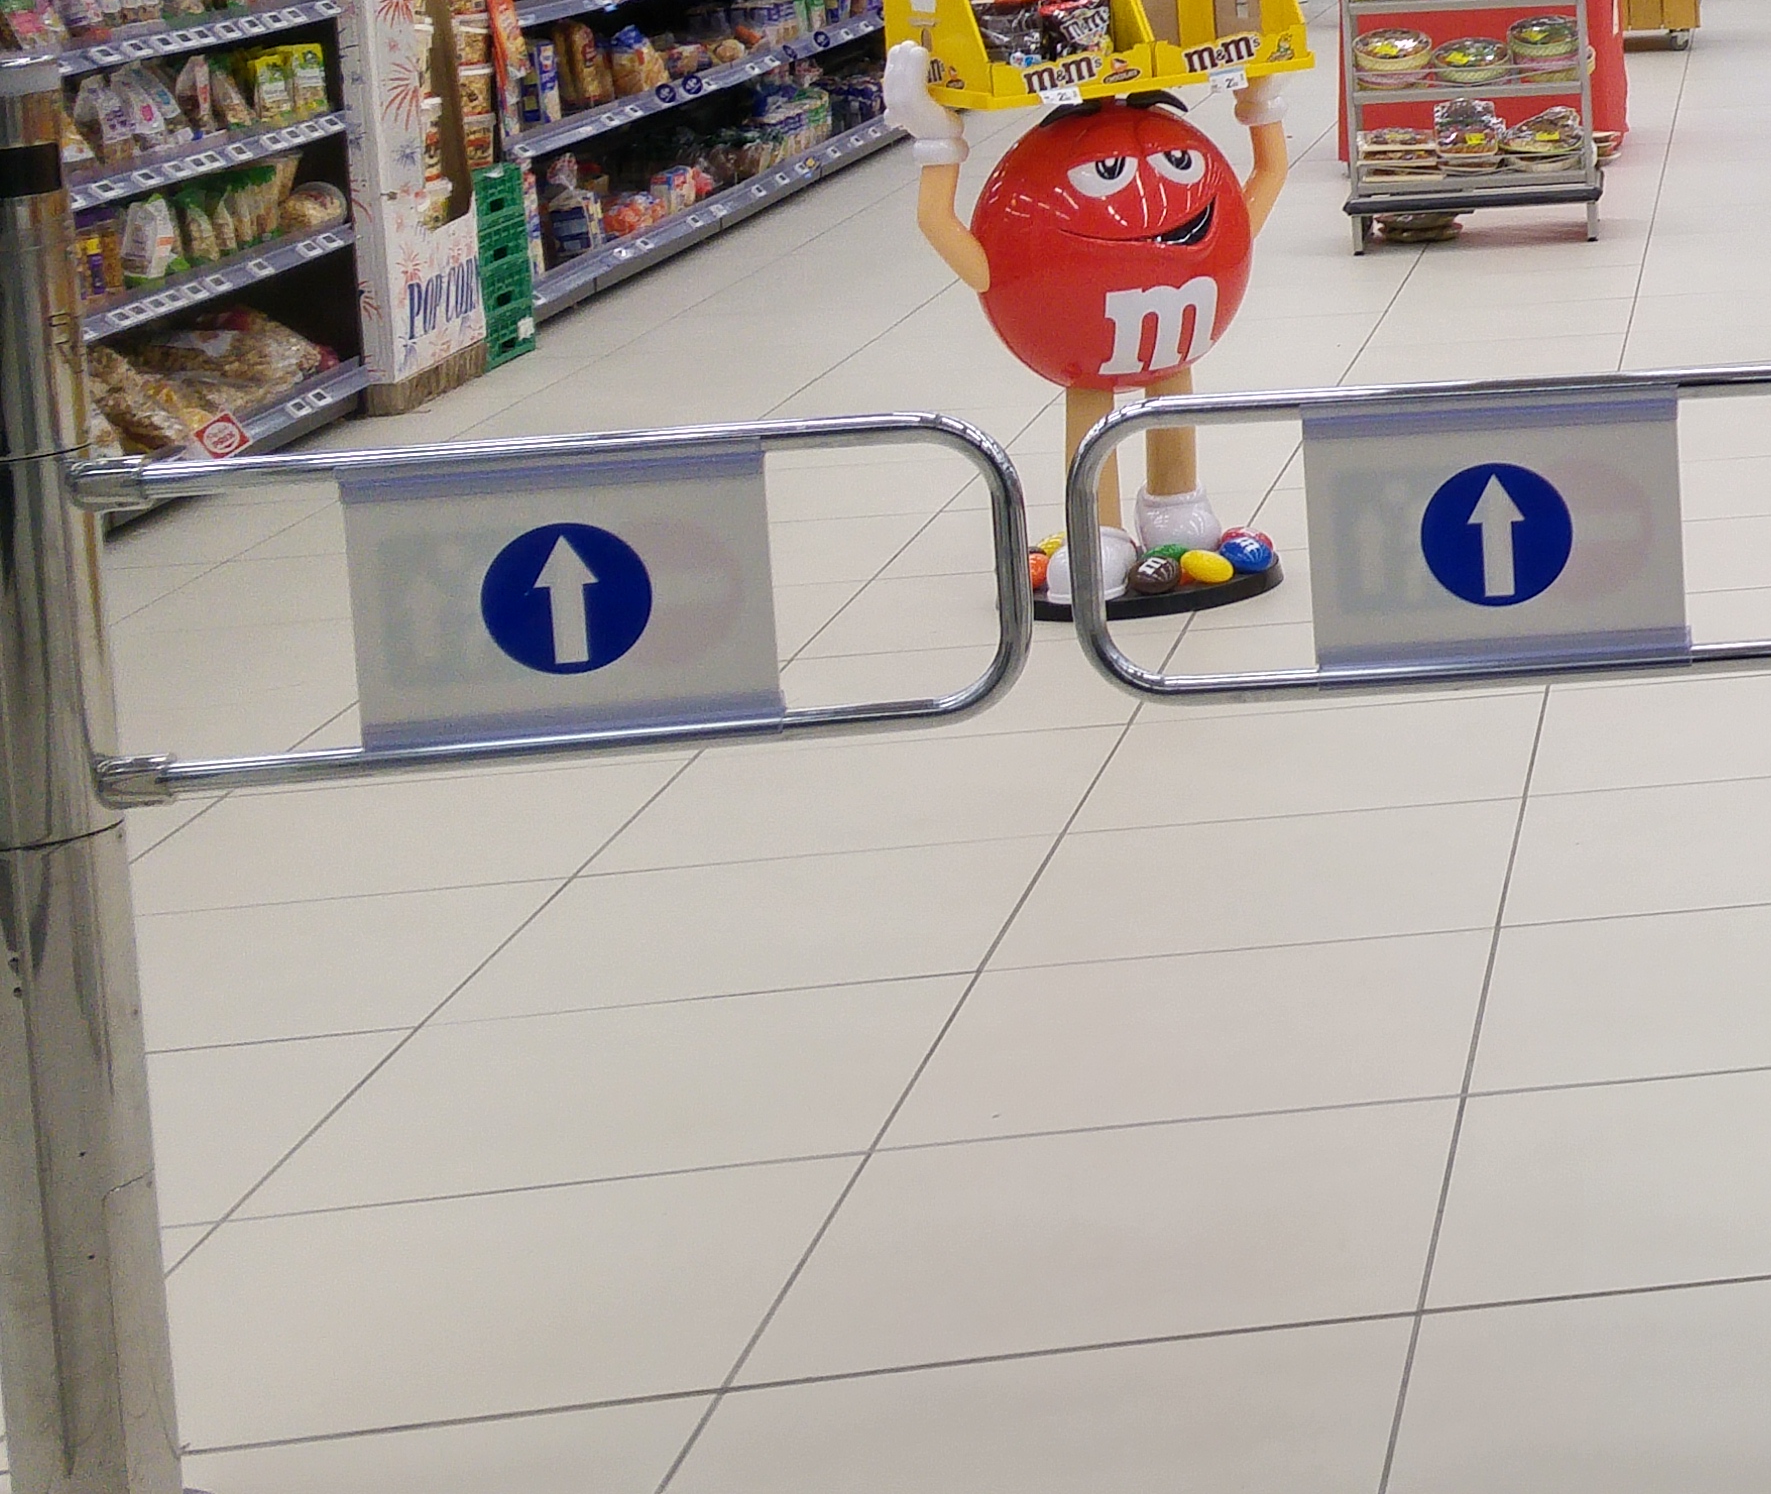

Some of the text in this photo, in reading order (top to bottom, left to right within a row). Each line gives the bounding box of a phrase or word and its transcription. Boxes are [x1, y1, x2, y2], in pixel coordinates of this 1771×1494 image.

[1024, 55, 1102, 94] m&m's
[1184, 35, 1261, 73] m&m's
[407, 272, 443, 341] POP
[1097, 275, 1218, 375] m
